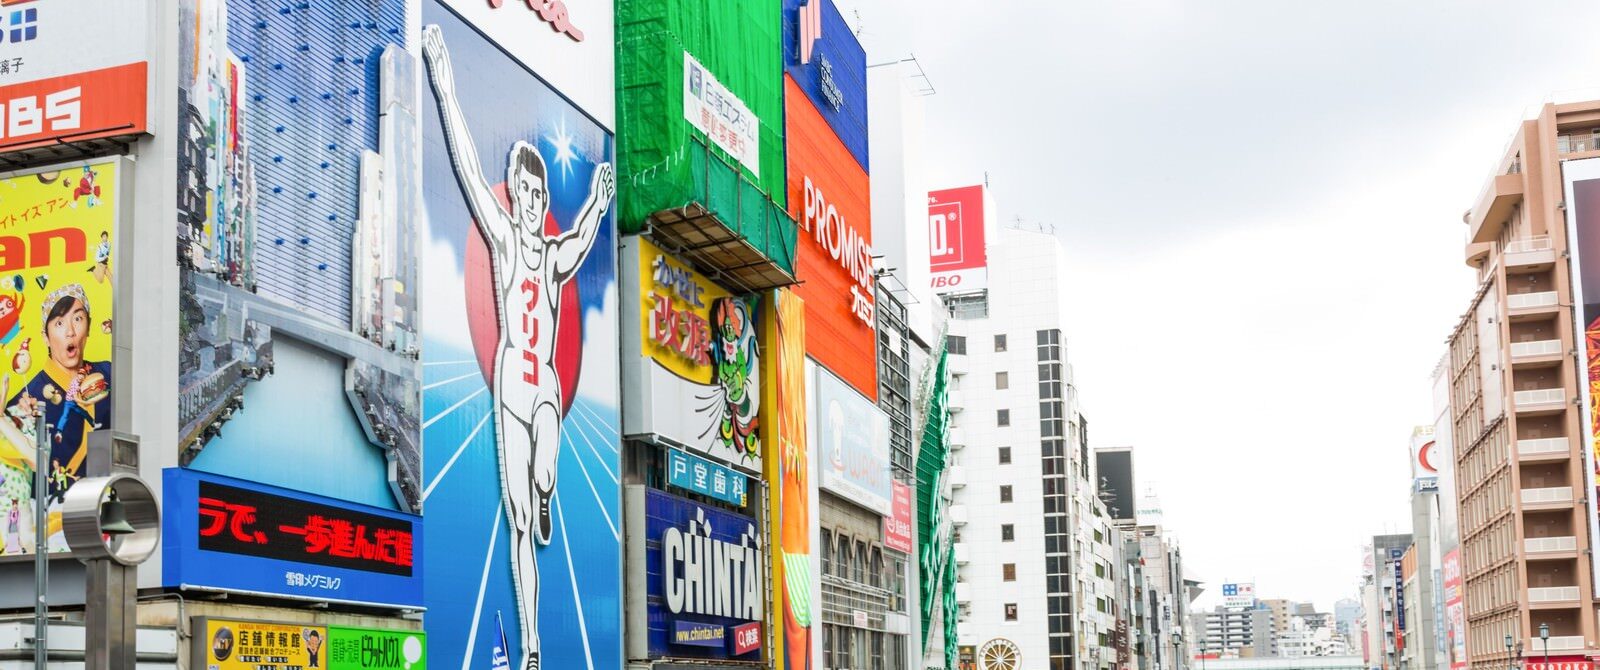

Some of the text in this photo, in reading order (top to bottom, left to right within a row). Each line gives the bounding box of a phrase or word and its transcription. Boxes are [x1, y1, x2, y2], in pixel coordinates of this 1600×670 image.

[0, 85, 81, 139] BS
[803, 175, 875, 296] PROMISE
[521, 275, 541, 387] グリコ
[648, 291, 710, 367] 改源
[673, 454, 745, 499] 戸堂歯科
[285, 572, 341, 590] 雪印メグミルク
[665, 507, 764, 622] CHINTAI
